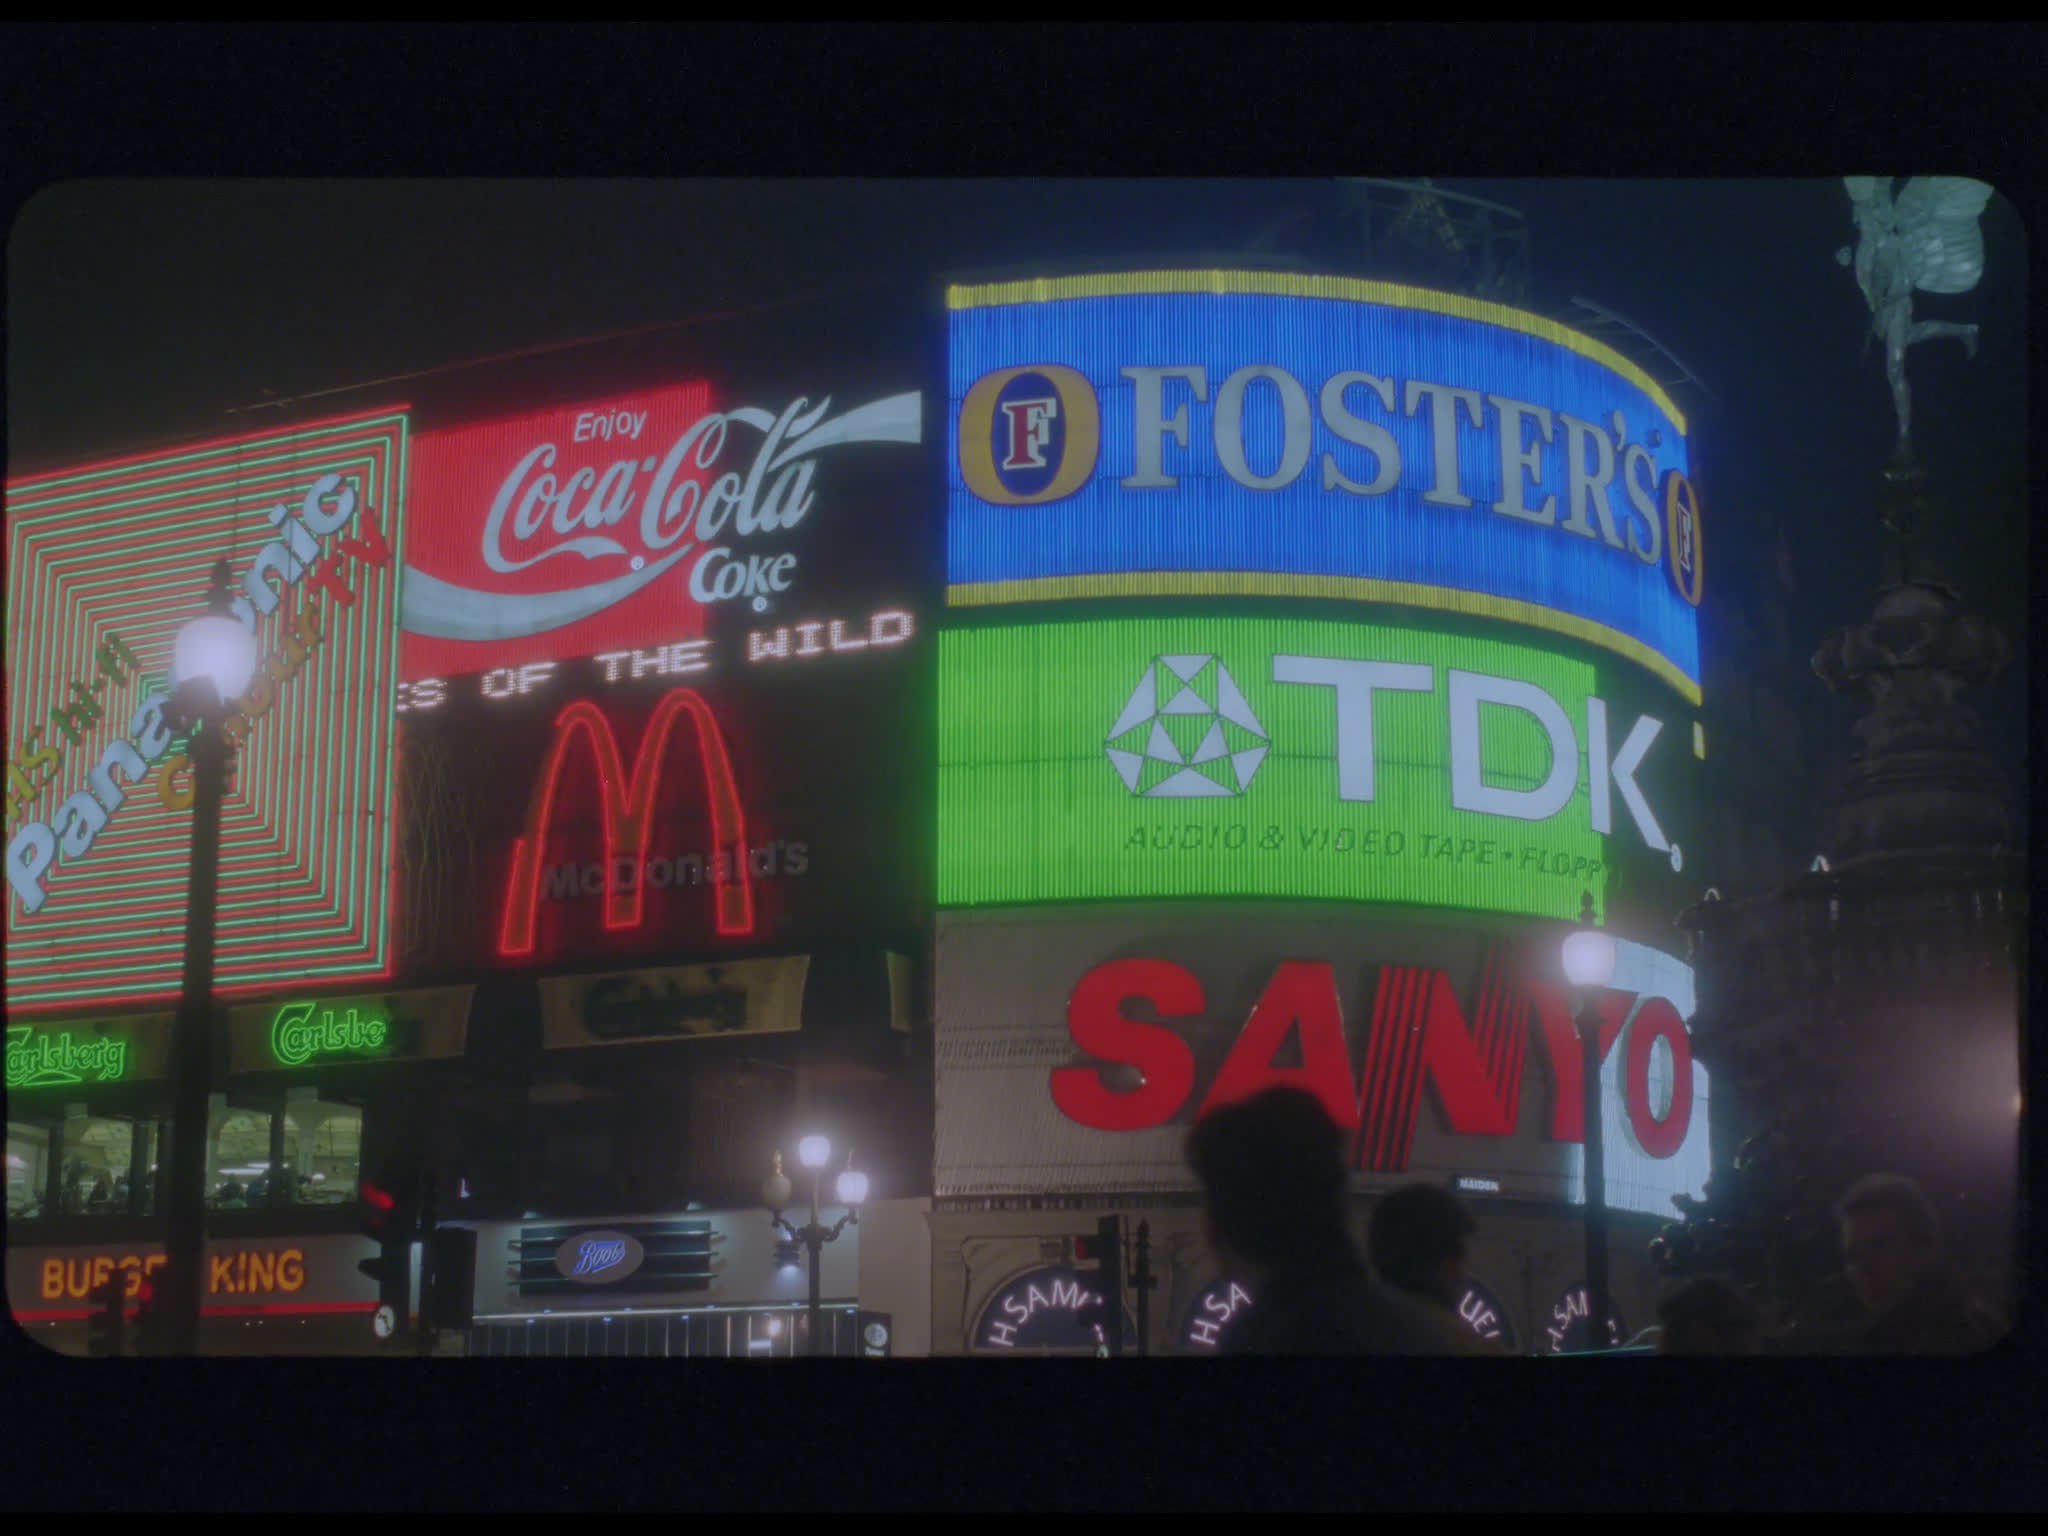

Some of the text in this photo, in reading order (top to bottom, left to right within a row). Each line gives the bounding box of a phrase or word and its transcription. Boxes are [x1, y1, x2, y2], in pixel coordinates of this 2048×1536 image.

[573, 408, 647, 443] Enjoy
[1120, 363, 1662, 565] FOSTER'S
[482, 394, 832, 573] Coca-Cola
[305, 507, 390, 606] TV
[689, 547, 797, 603] Coke
[7, 473, 357, 911] Pananic
[480, 662, 558, 698] OF
[594, 639, 715, 682] THE
[749, 610, 914, 660] WILD
[1272, 652, 1670, 853] TDK
[541, 838, 809, 898] McDonald's
[1124, 824, 1606, 880] AUDIO & VIDEO TAPE FLOPP
[1050, 938, 1694, 1172] SANYO
[209, 1248, 304, 1294] KING
